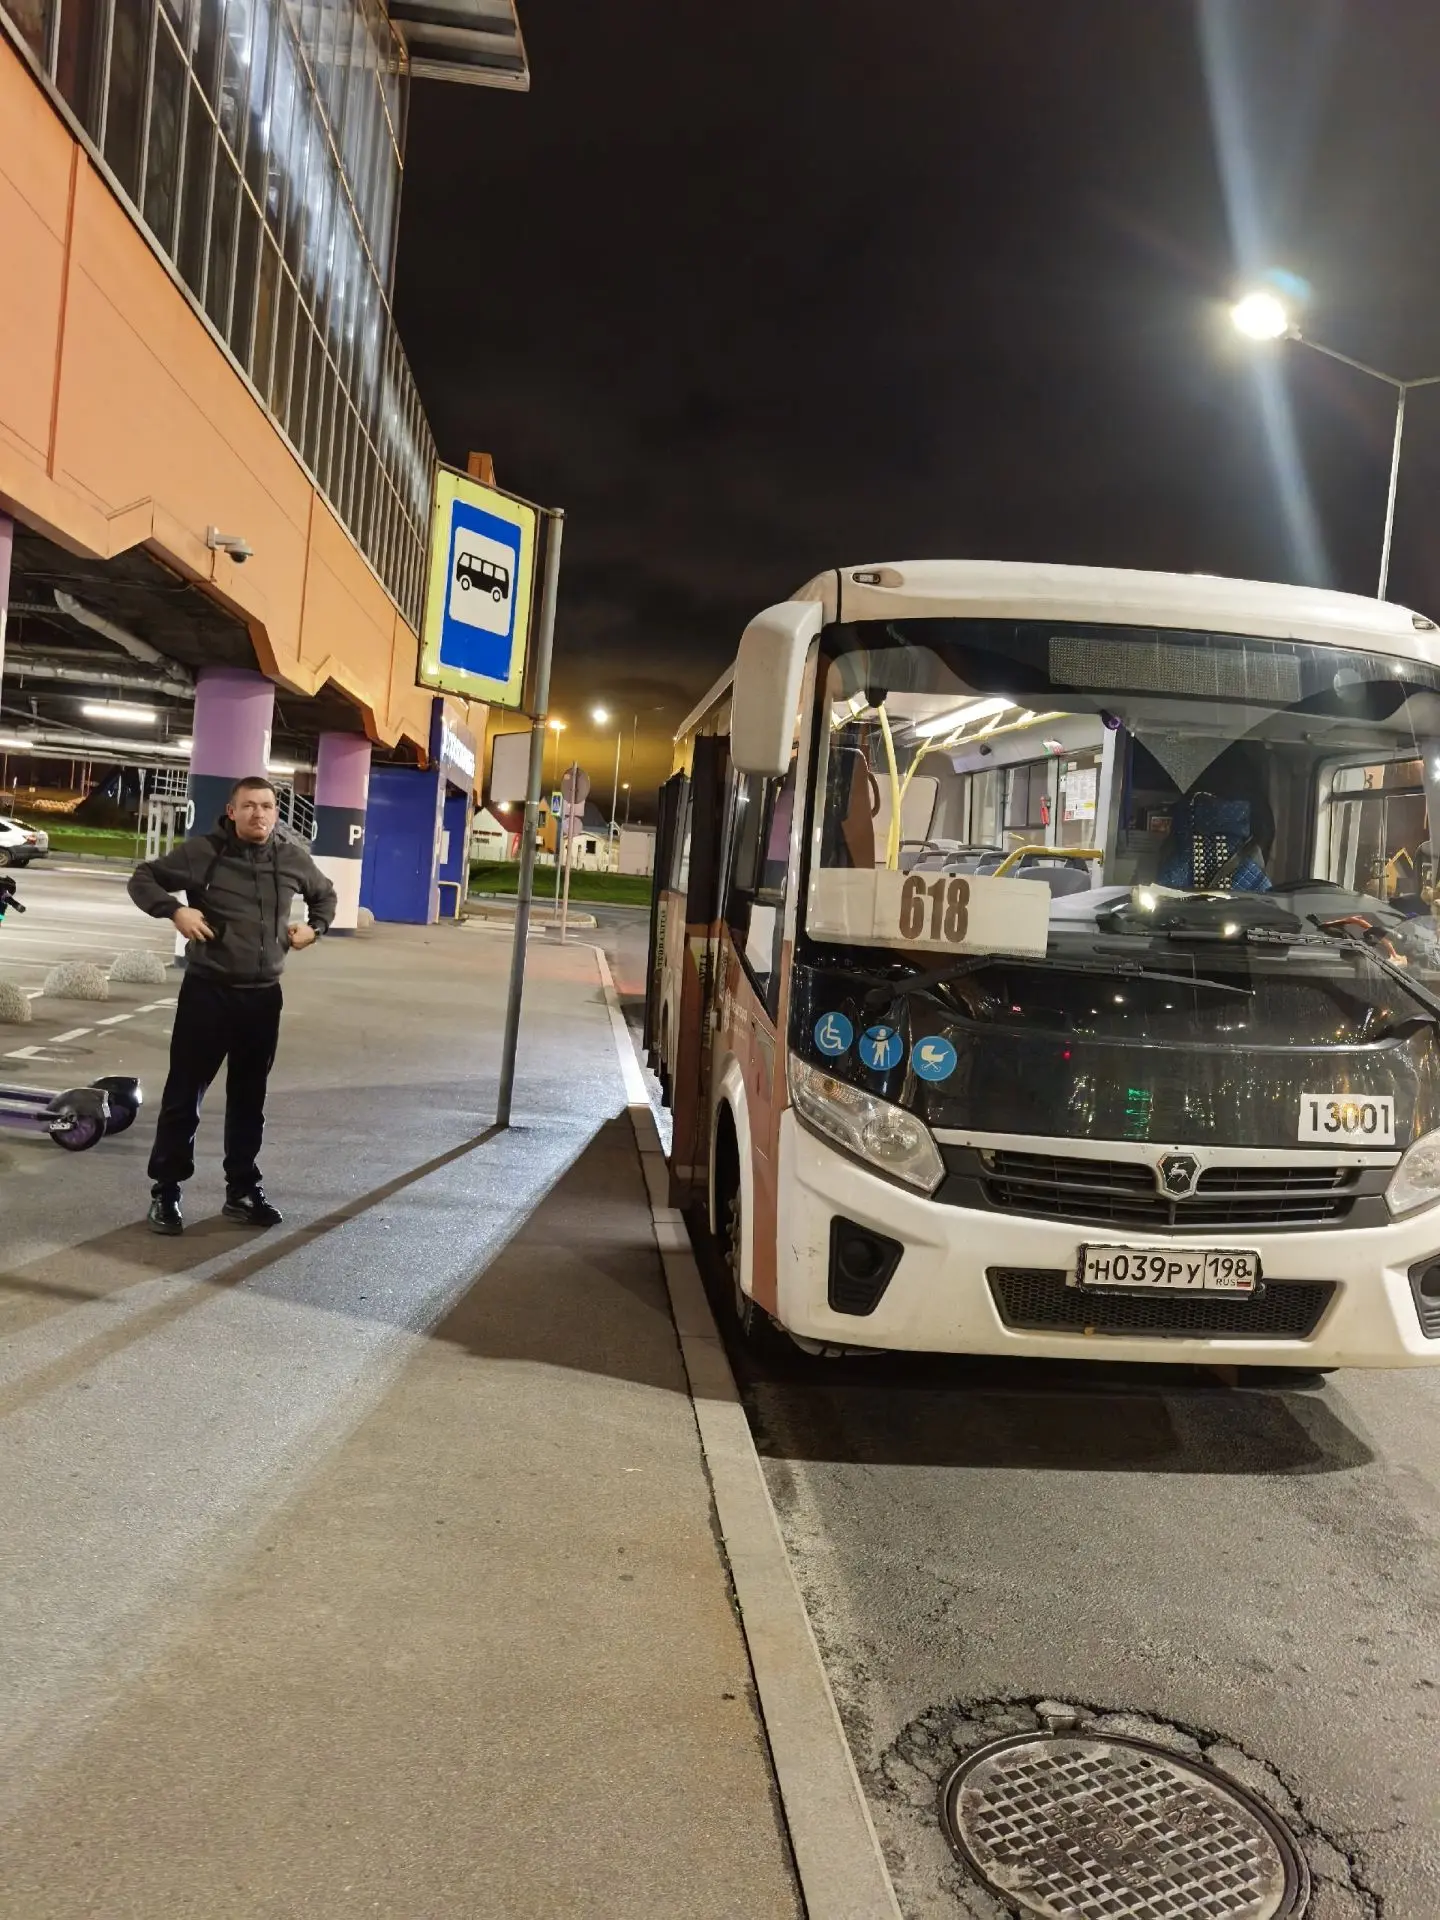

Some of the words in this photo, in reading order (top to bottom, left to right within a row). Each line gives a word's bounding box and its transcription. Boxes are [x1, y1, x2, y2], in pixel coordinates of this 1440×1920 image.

[898, 875, 971, 944] 618
[1309, 1101, 1390, 1135] 13001
[1208, 1257, 1248, 1279] 198
[1215, 1278, 1236, 1287] RUS
